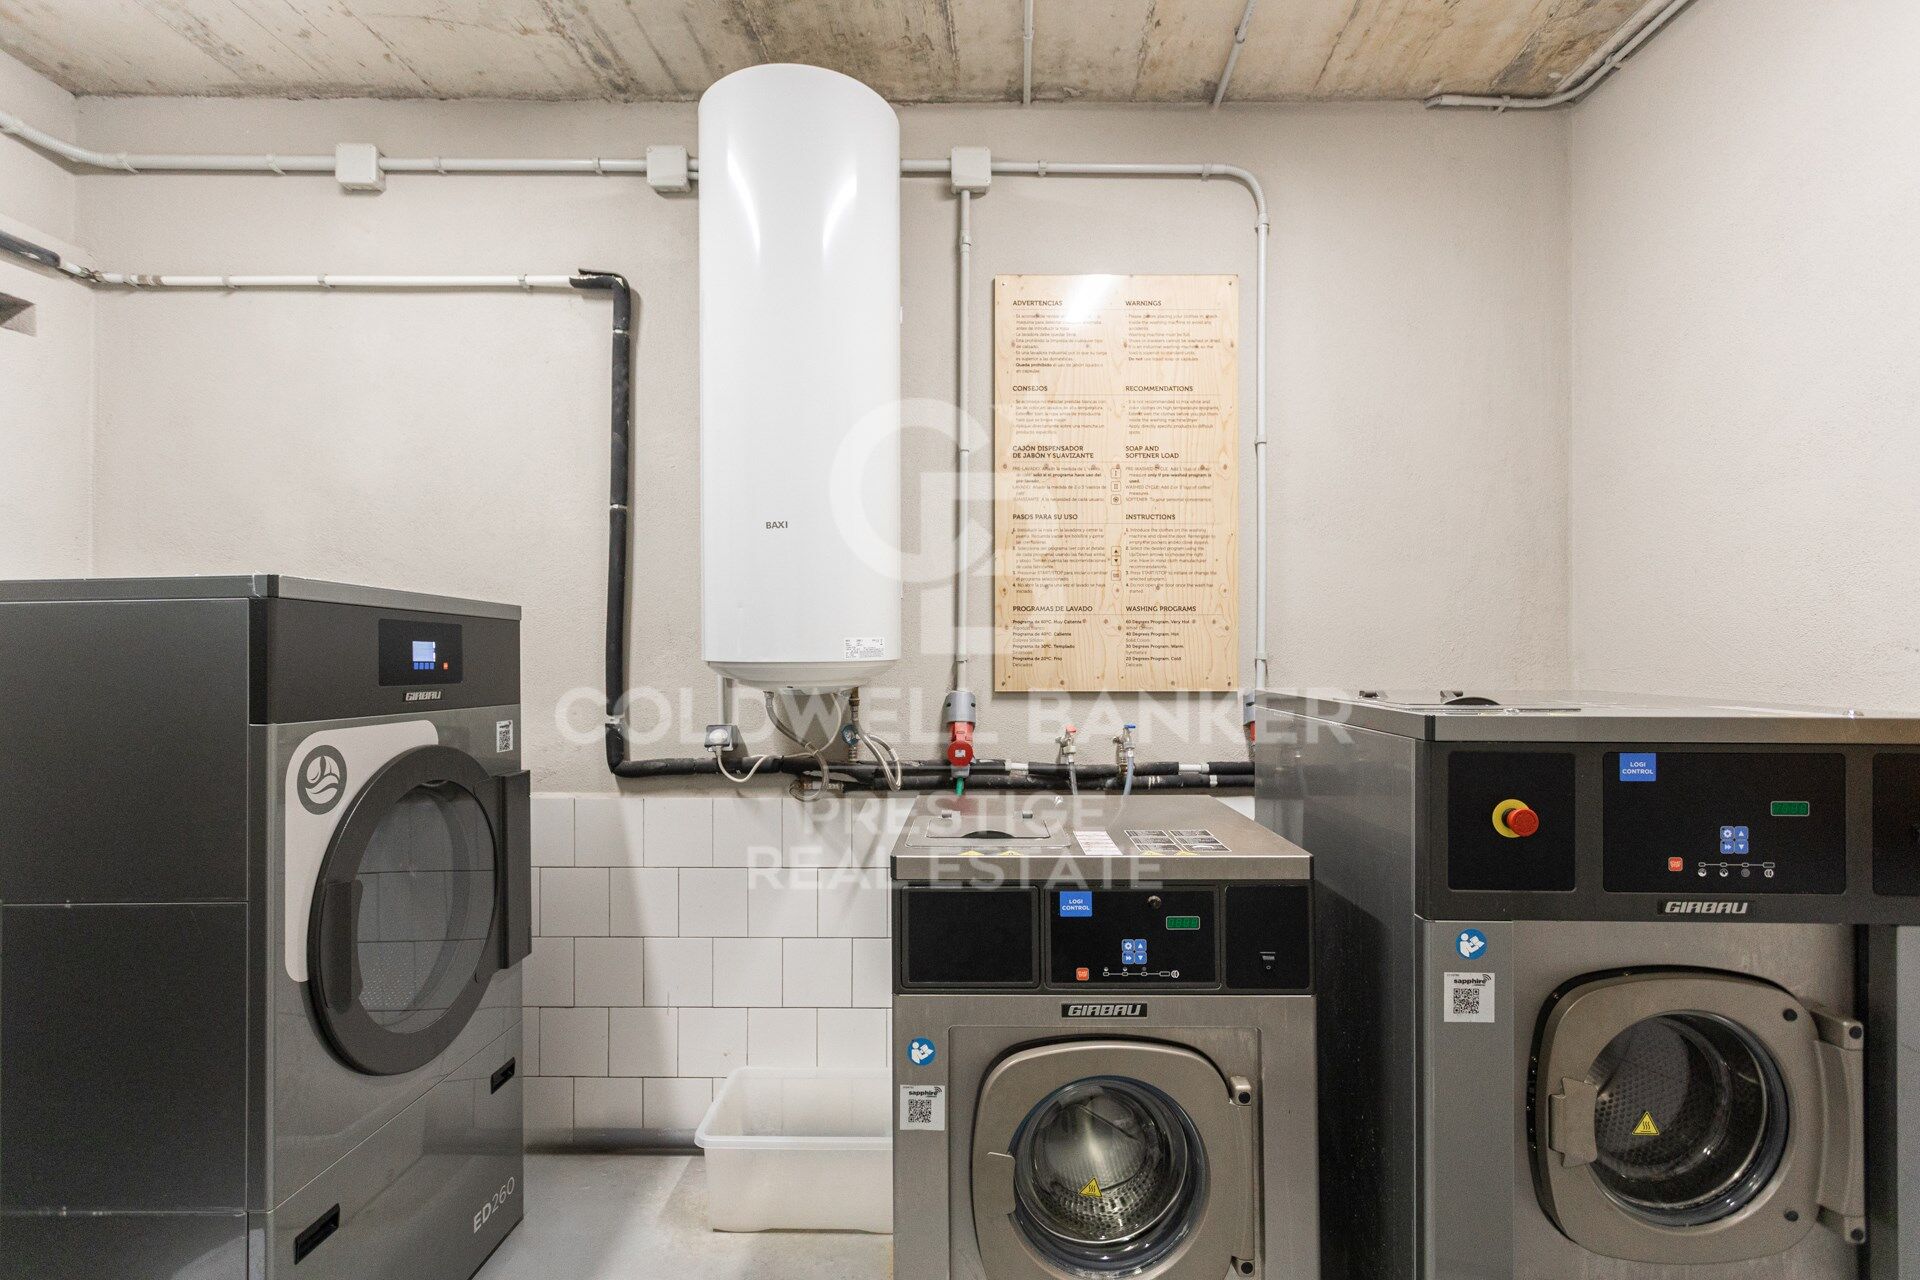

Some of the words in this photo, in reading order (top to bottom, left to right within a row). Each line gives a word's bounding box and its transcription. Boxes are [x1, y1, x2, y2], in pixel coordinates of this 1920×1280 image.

[765, 520, 788, 529] BAXI
[405, 690, 442, 701] GIRBAU
[1664, 901, 1748, 914] GIRBAU
[1067, 1004, 1141, 1016] GIRBAU
